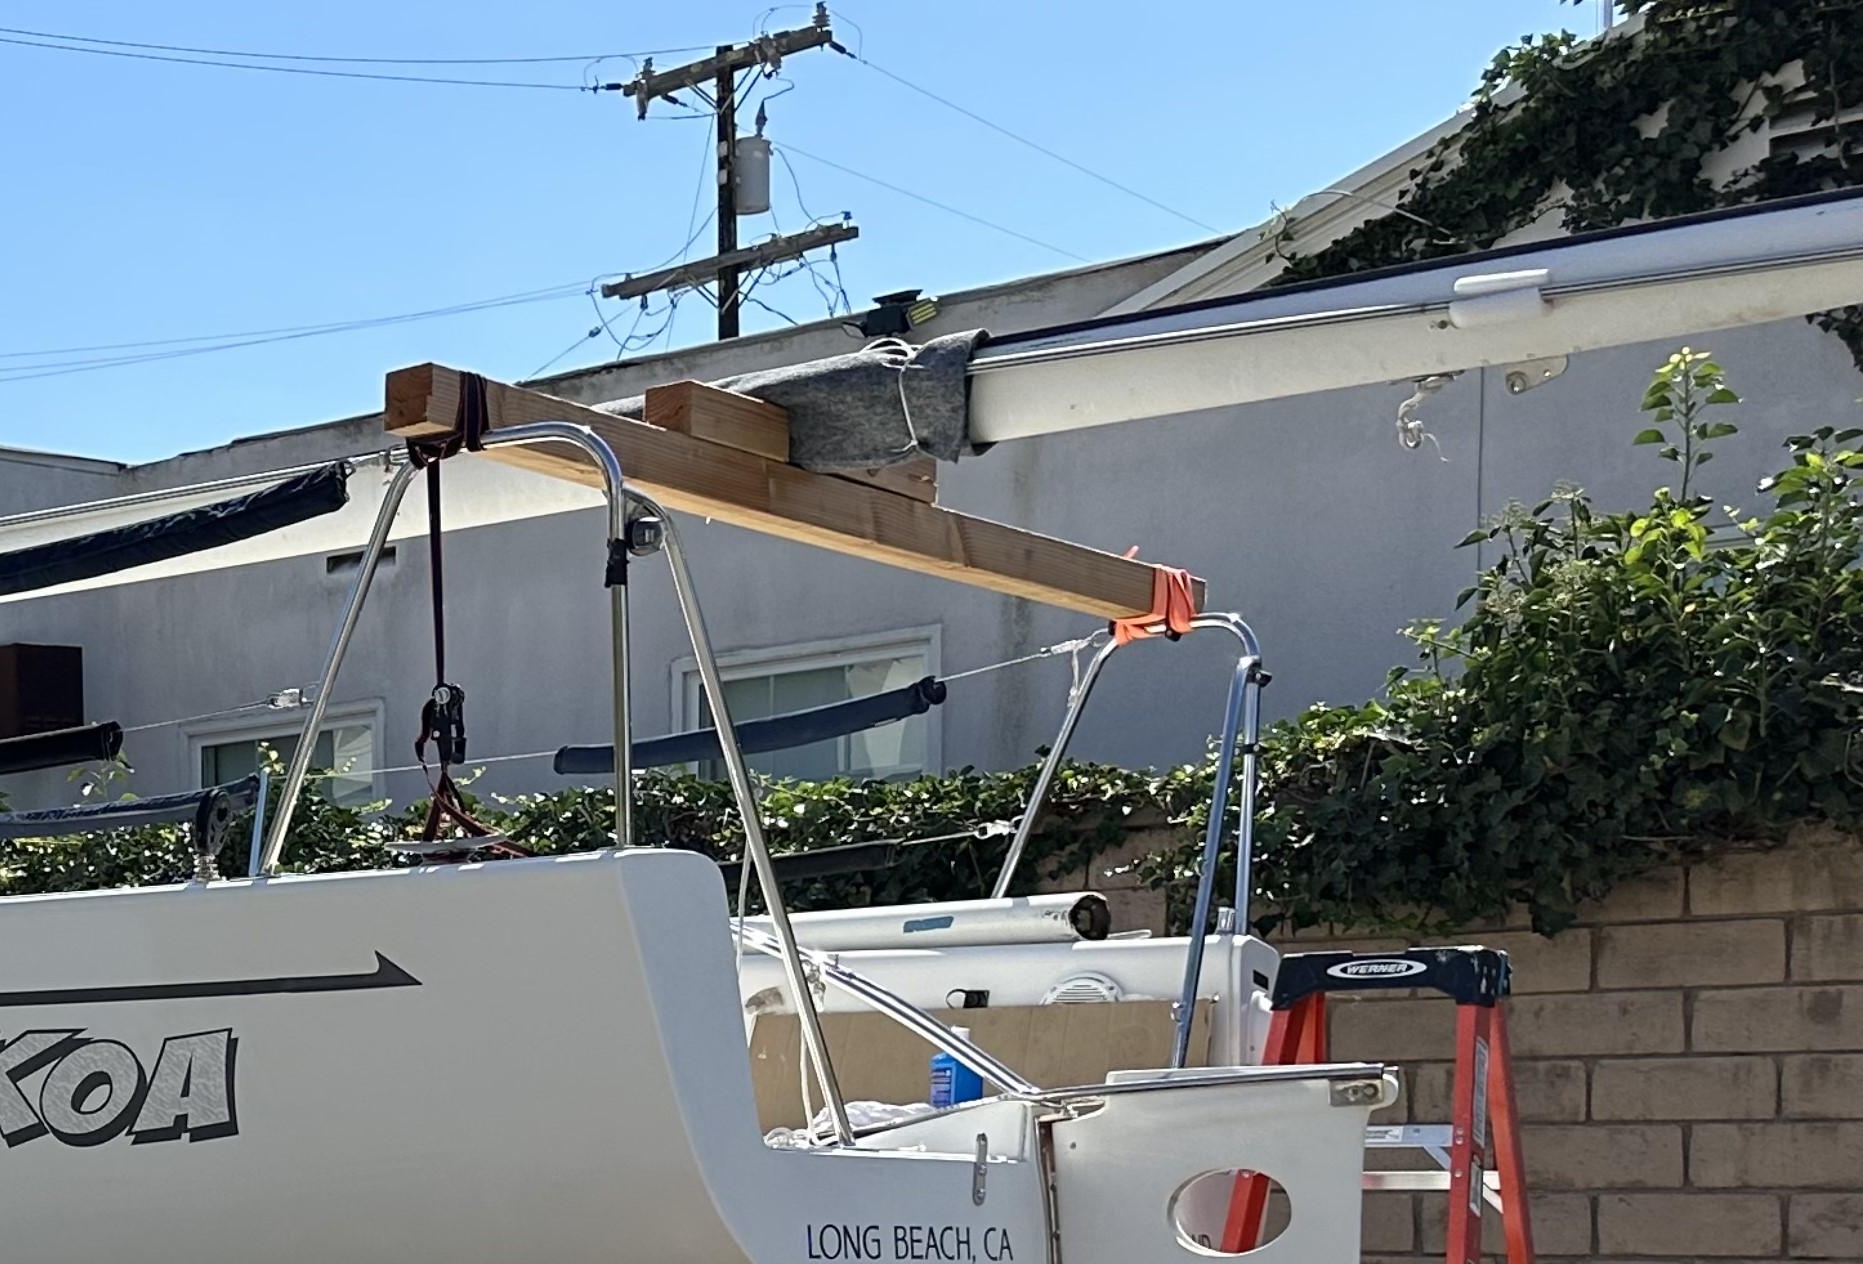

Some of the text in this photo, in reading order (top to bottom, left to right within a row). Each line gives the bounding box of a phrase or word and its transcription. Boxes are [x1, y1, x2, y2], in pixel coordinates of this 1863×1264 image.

[1345, 963, 1408, 976] WERNER
[807, 1224, 1014, 1264] LONG BEACH, CA
